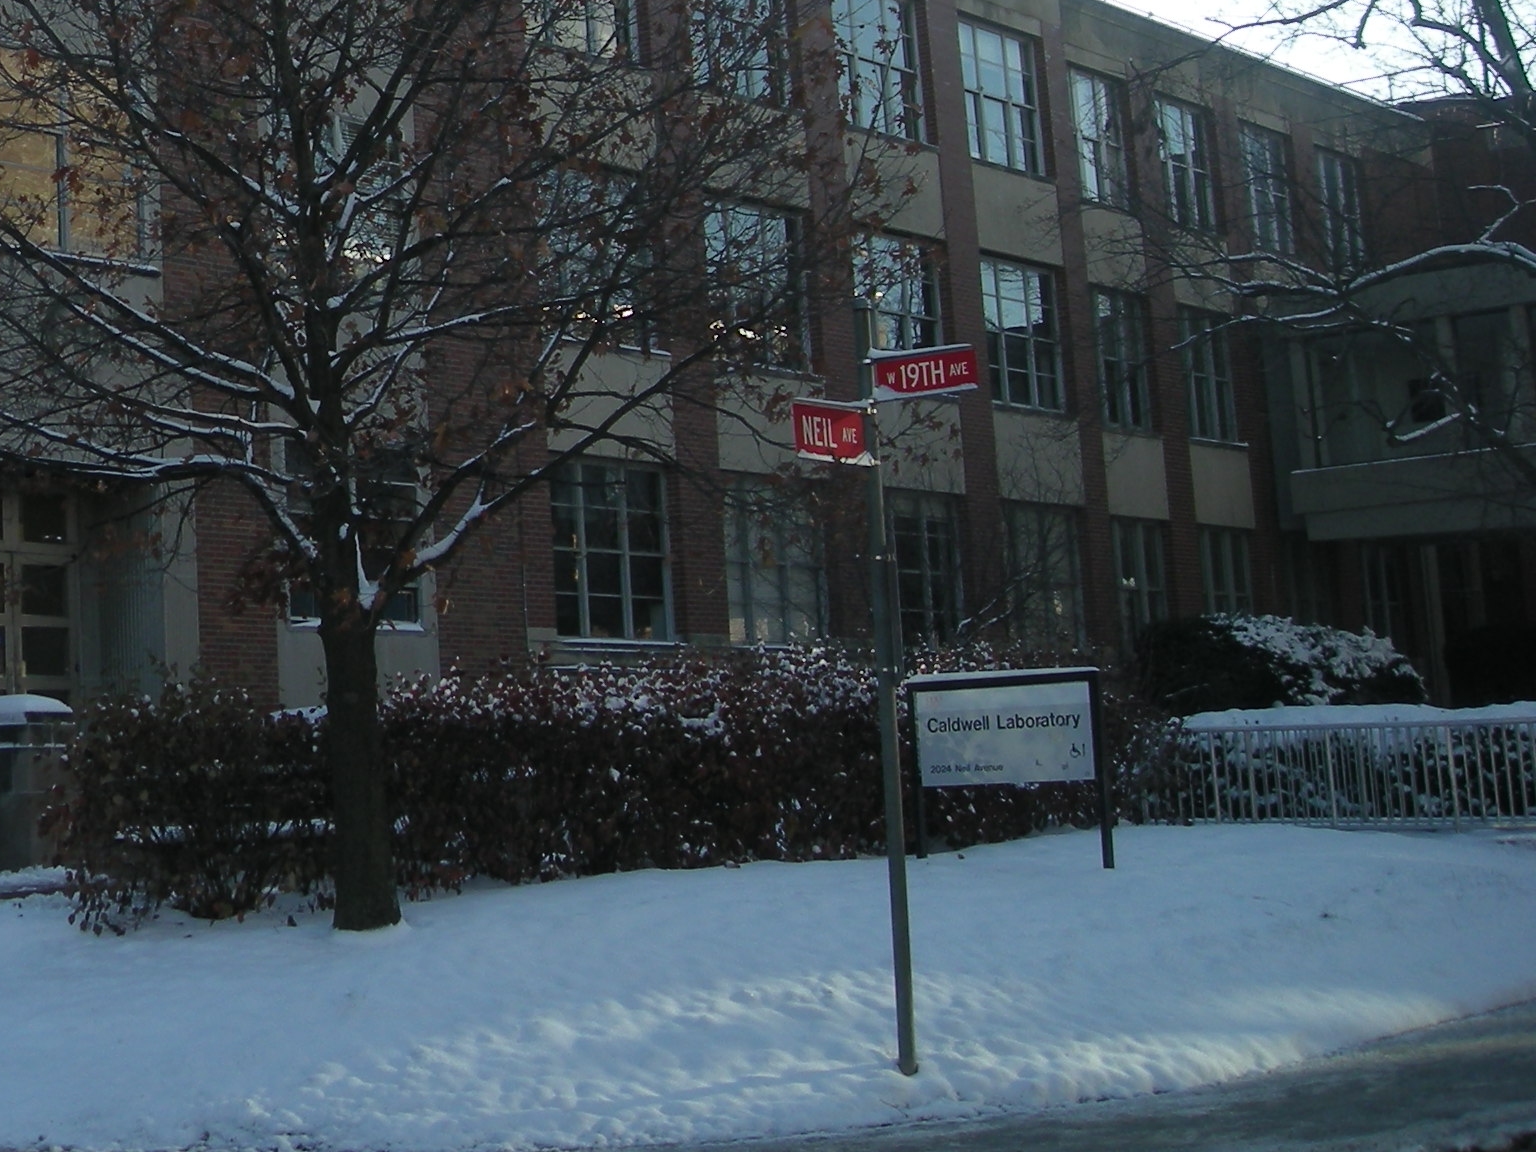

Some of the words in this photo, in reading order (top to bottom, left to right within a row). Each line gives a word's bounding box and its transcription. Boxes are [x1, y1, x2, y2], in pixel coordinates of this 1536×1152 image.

[886, 371, 896, 385] W
[899, 359, 945, 390] 19TH
[949, 361, 970, 377] AVE
[801, 414, 838, 449] NEIL
[842, 426, 858, 445] AVE
[927, 715, 990, 734] Caldwell
[996, 712, 1081, 730] Laboratory
[930, 764, 952, 774] 2024
[955, 763, 971, 773] Neil
[974, 763, 1004, 772] Avenue
